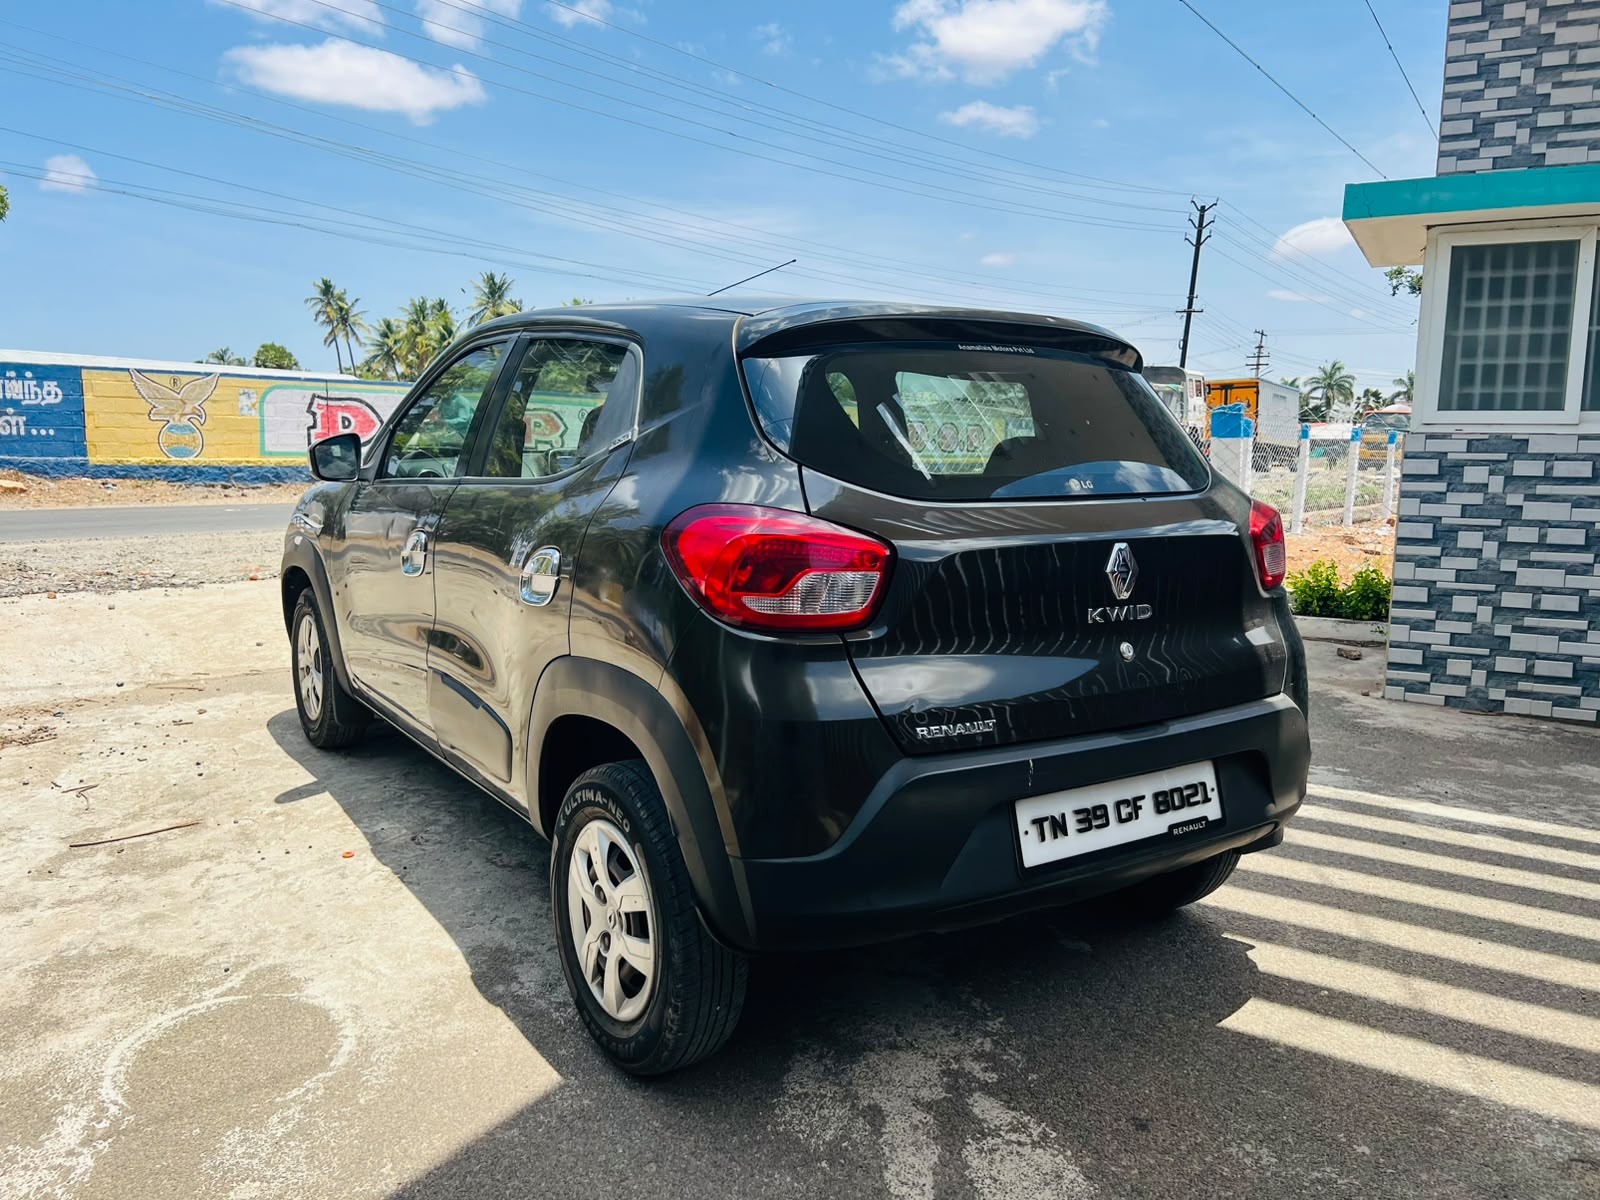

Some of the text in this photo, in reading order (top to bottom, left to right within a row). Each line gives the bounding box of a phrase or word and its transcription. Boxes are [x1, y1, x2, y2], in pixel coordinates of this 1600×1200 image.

[1087, 603, 1153, 624] KWID
[915, 719, 997, 739] RENAULT
[1031, 781, 1213, 843] TN 39 CF 8021
[1172, 820, 1207, 836] RENAULT
